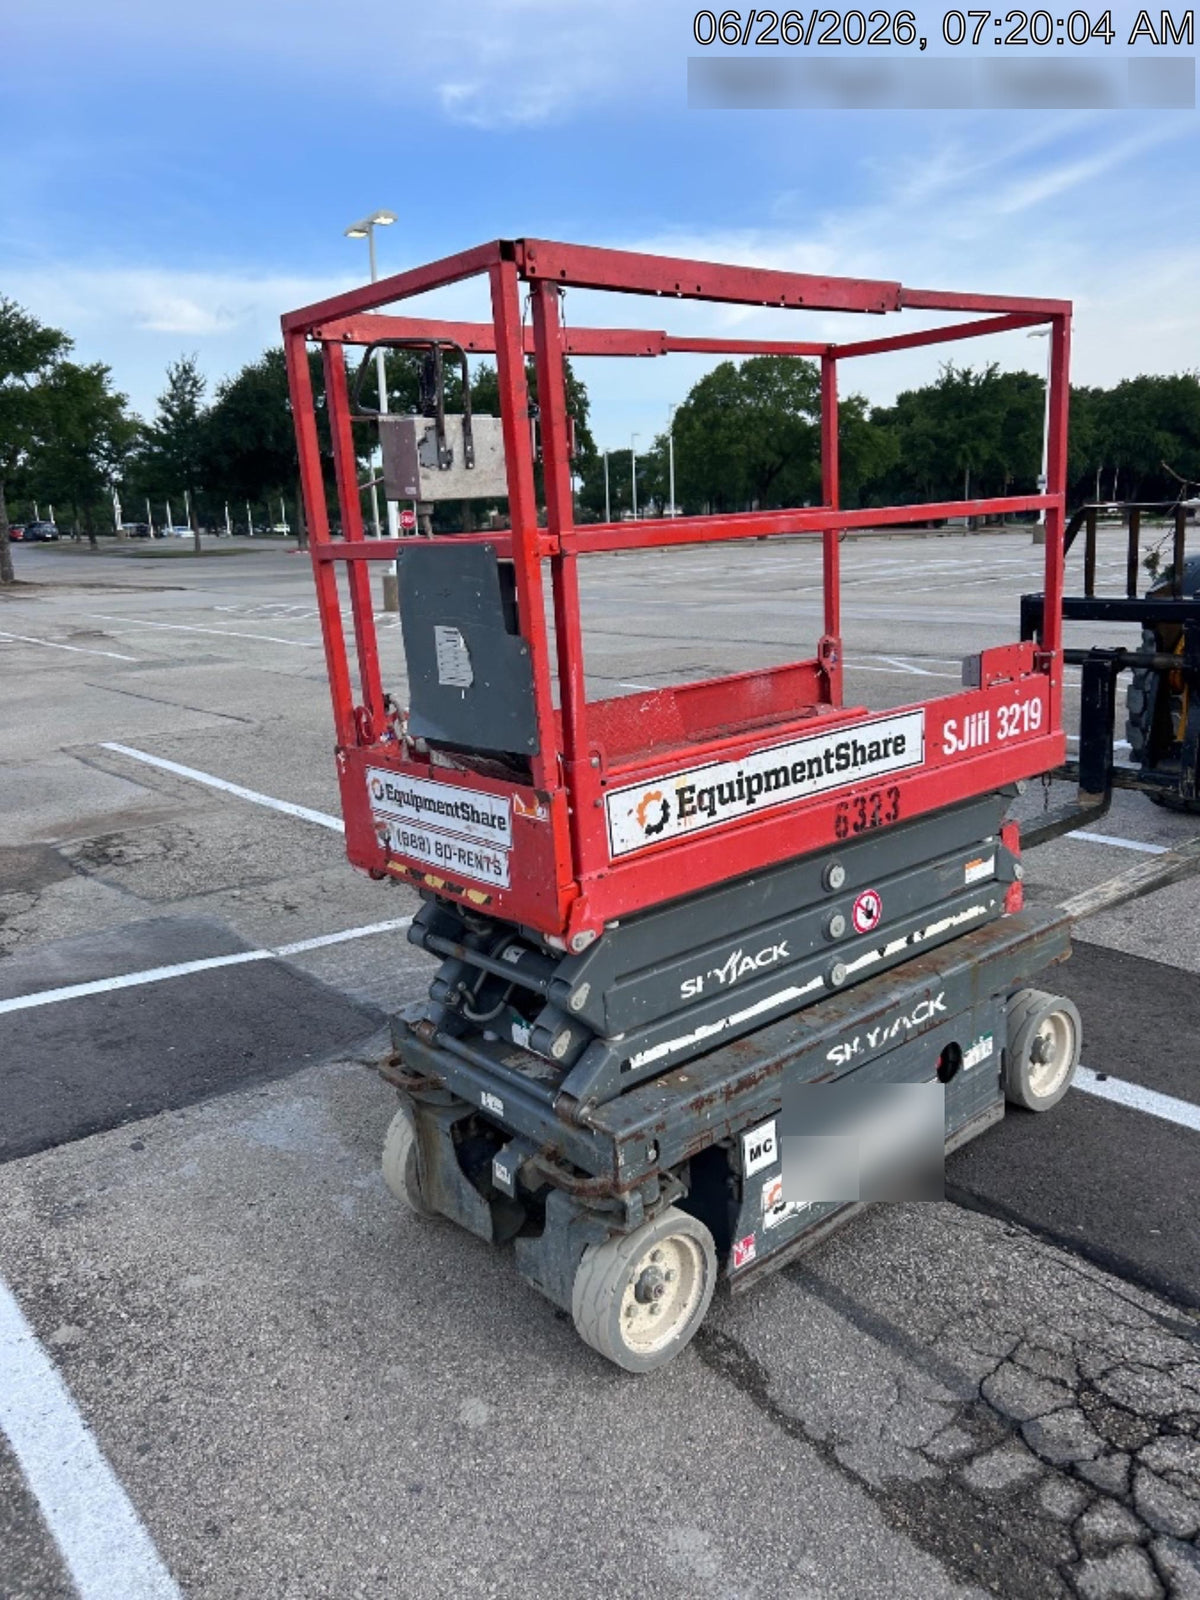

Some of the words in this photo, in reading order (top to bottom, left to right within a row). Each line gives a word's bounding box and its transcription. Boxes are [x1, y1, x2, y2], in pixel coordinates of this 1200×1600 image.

[997, 697, 1042, 740] 3219
[674, 732, 906, 819] EquipmentShare
[385, 783, 507, 832] EquipmentShare
[749, 1138, 773, 1163] MC
